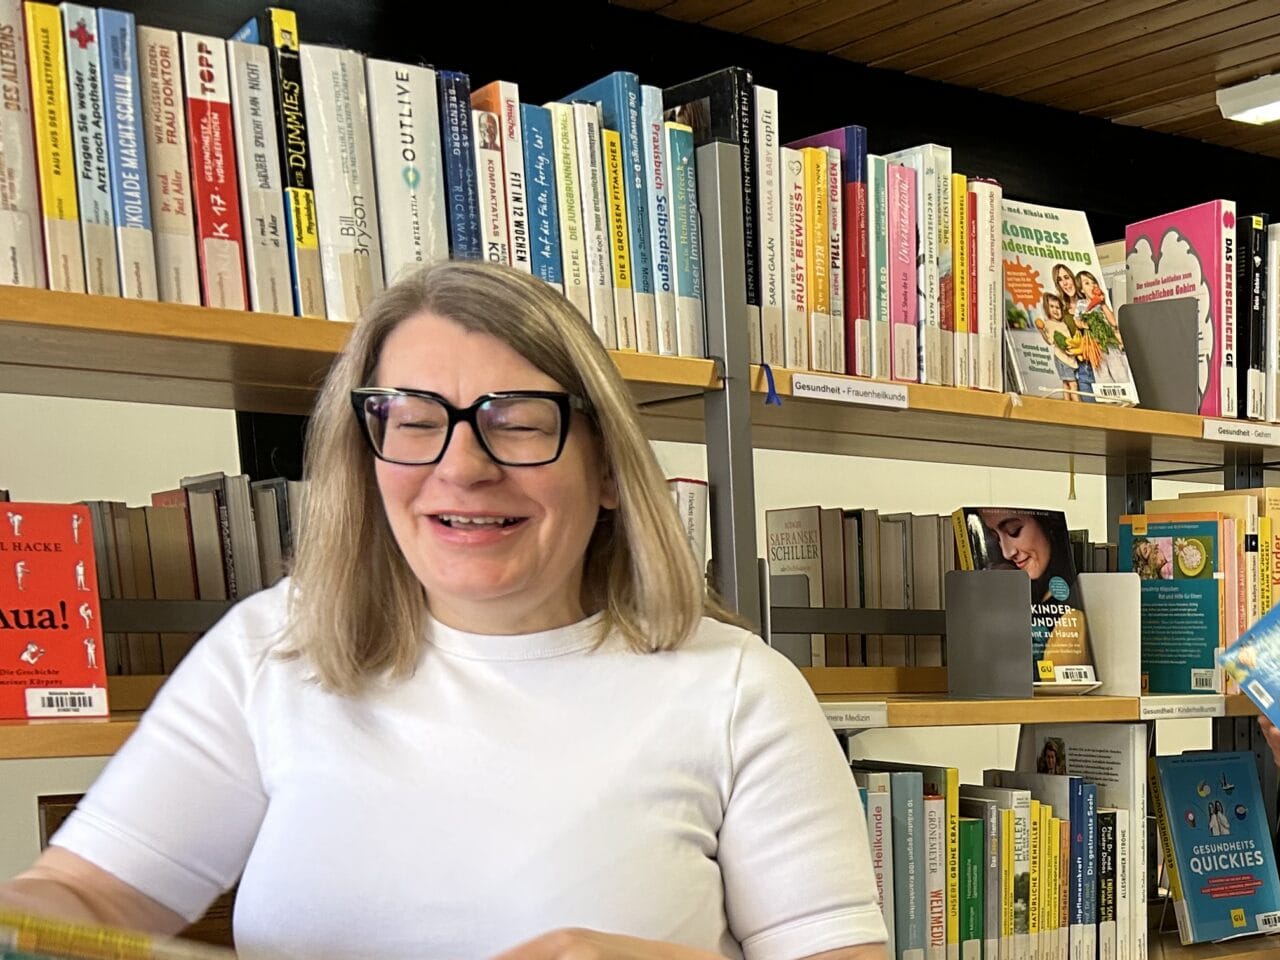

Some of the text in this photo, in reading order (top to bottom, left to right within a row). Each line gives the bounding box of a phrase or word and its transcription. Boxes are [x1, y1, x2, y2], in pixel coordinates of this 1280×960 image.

[197, 41, 215, 95] TOPP
[246, 63, 260, 91] NICHT
[113, 74, 134, 122] SCHLAU
[159, 45, 177, 144] FRAU DOKTOR!
[249, 97, 262, 117] MAN
[75, 70, 94, 180] Fragen Sie weder
[88, 62, 108, 193] Arzt noch Apotheker
[282, 80, 307, 169] DUMMIES
[395, 70, 416, 161] OUTLIVE
[448, 89, 461, 156] BRENDBORG
[459, 101, 469, 147] NICKLAS
[506, 99, 515, 139] Umschau
[761, 110, 776, 147] topfit
[117, 124, 139, 168] MACHT
[200, 124, 213, 182] GESUNDHEIT
[651, 123, 664, 190] Praxisbuch
[741, 91, 752, 193] EIN KIND ENTSTEHT
[171, 170, 183, 195] Adler
[766, 151, 774, 176] BABY
[830, 163, 839, 203] FOLGEN
[487, 159, 500, 237] KOMPAKTATLAS
[510, 172, 528, 262] FIT IN 12 WOCHEN
[609, 141, 627, 280] DIE GROSSEN FITMACHER
[688, 167, 700, 260] Immunsystem
[339, 216, 356, 237] Bill
[540, 218, 550, 236] die
[569, 225, 578, 240] DIE
[793, 183, 805, 259] BEWUSST
[927, 193, 936, 265] WECHSELJAHRE
[1002, 221, 1070, 246] Kompass
[540, 236, 551, 259] Auf
[1002, 239, 1092, 266] nderernährung
[768, 273, 777, 306] SARAH
[1175, 284, 1196, 297] Gehirn
[1225, 238, 1233, 352] DAS MENSCHLICHE
[795, 382, 905, 402] Gesundheit Frauenheilkunde
[1218, 426, 1250, 437] Gesundheit
[12, 542, 63, 553] HACKE
[770, 530, 818, 546] SAFRANSKI
[771, 543, 820, 563] SCHILLER
[0, 600, 70, 631] Aua!
[1031, 617, 1078, 628] UNDHEIT
[1056, 629, 1079, 639] Hause
[1040, 665, 1053, 674] GU
[845, 713, 871, 723] Medizin
[1143, 706, 1174, 716] Gesundheit
[872, 806, 884, 868] Heilkunde
[928, 811, 938, 874] GRÖNEMEYER
[1014, 817, 1023, 862] HEILEN
[1087, 818, 1095, 860] gestresste
[1193, 839, 1255, 856] GESUNDHEITS
[949, 815, 958, 917] UNSERE GRÜNE KRAFT
[1189, 850, 1265, 875] QUICKIES
[929, 889, 944, 948] WELTMEDIZ
[1233, 913, 1244, 923] GU
